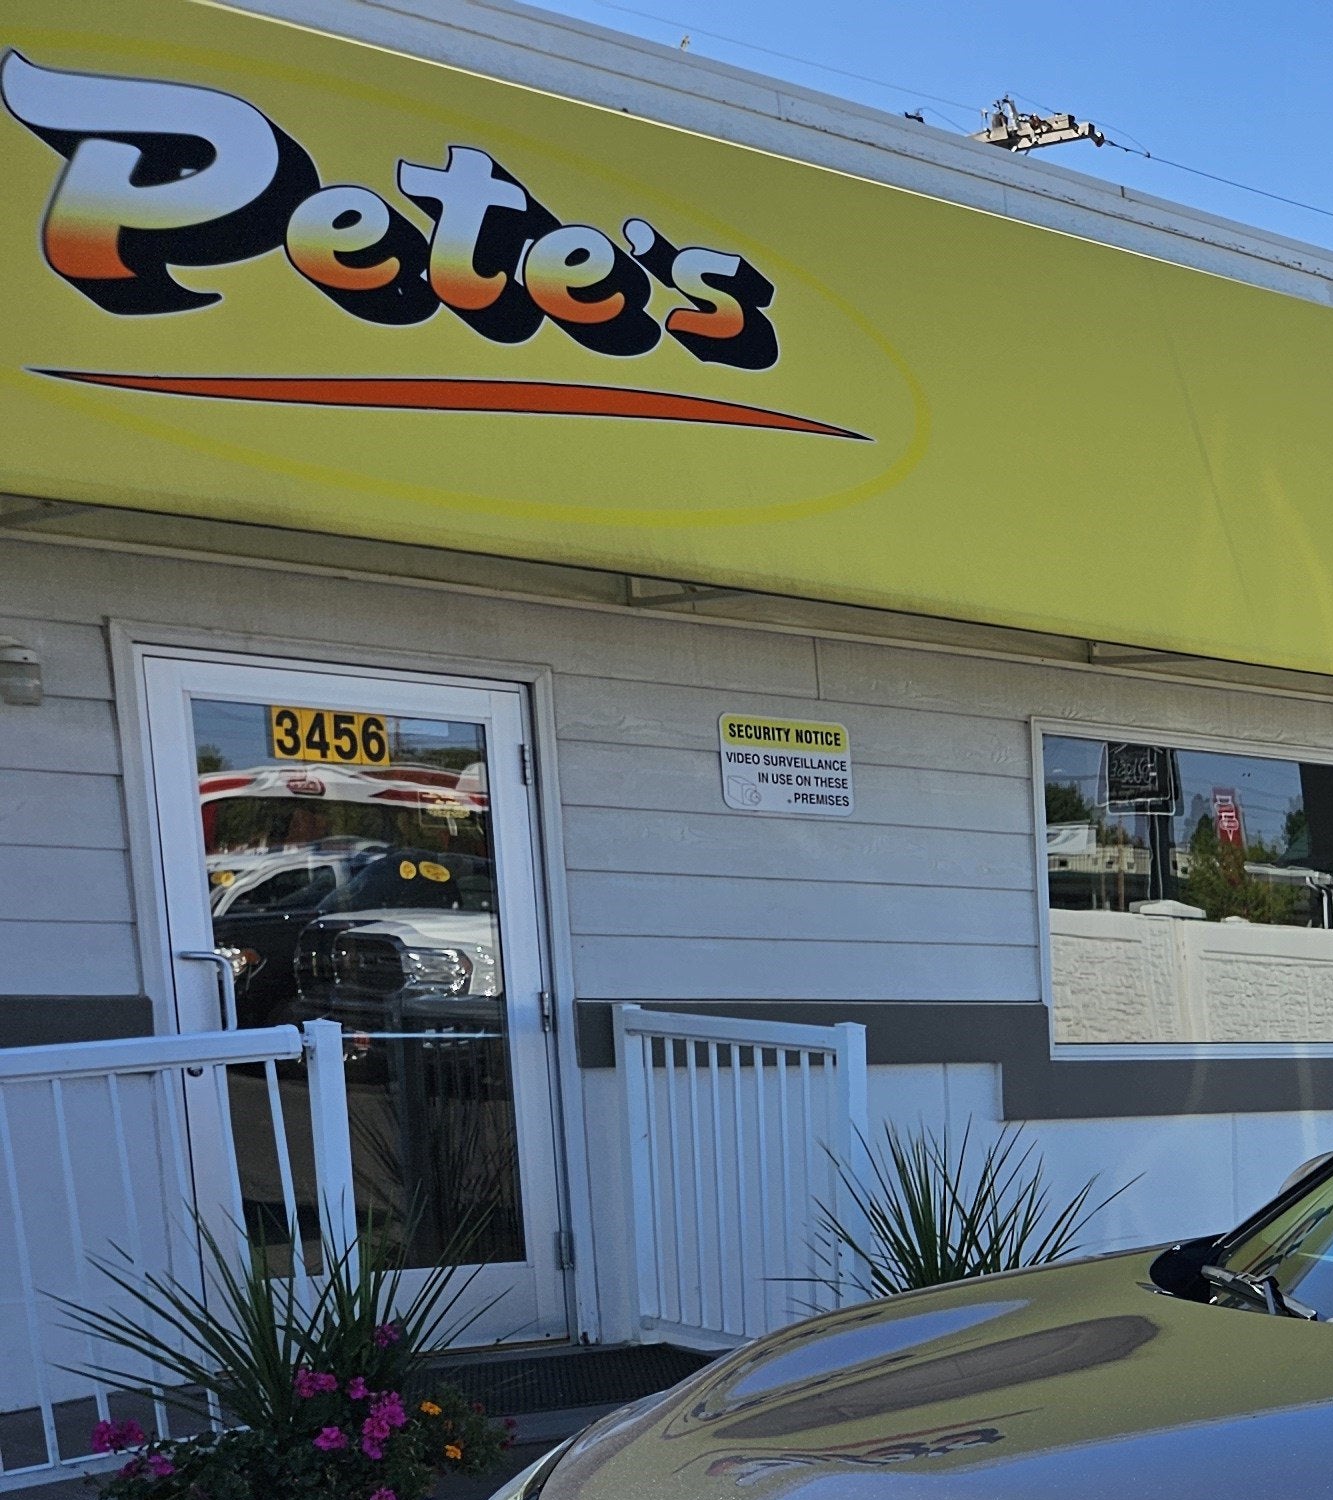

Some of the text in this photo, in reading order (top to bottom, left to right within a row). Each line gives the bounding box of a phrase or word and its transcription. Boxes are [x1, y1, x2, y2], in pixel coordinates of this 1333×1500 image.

[2, 48, 772, 362] Pete's
[275, 709, 386, 762] 3456
[728, 723, 841, 747] SECURITY NOTICE
[726, 752, 847, 772] VIDEO SURVEILLANCE
[758, 772, 848, 790] IN USE ON THESE
[794, 793, 850, 807] PREMISES
